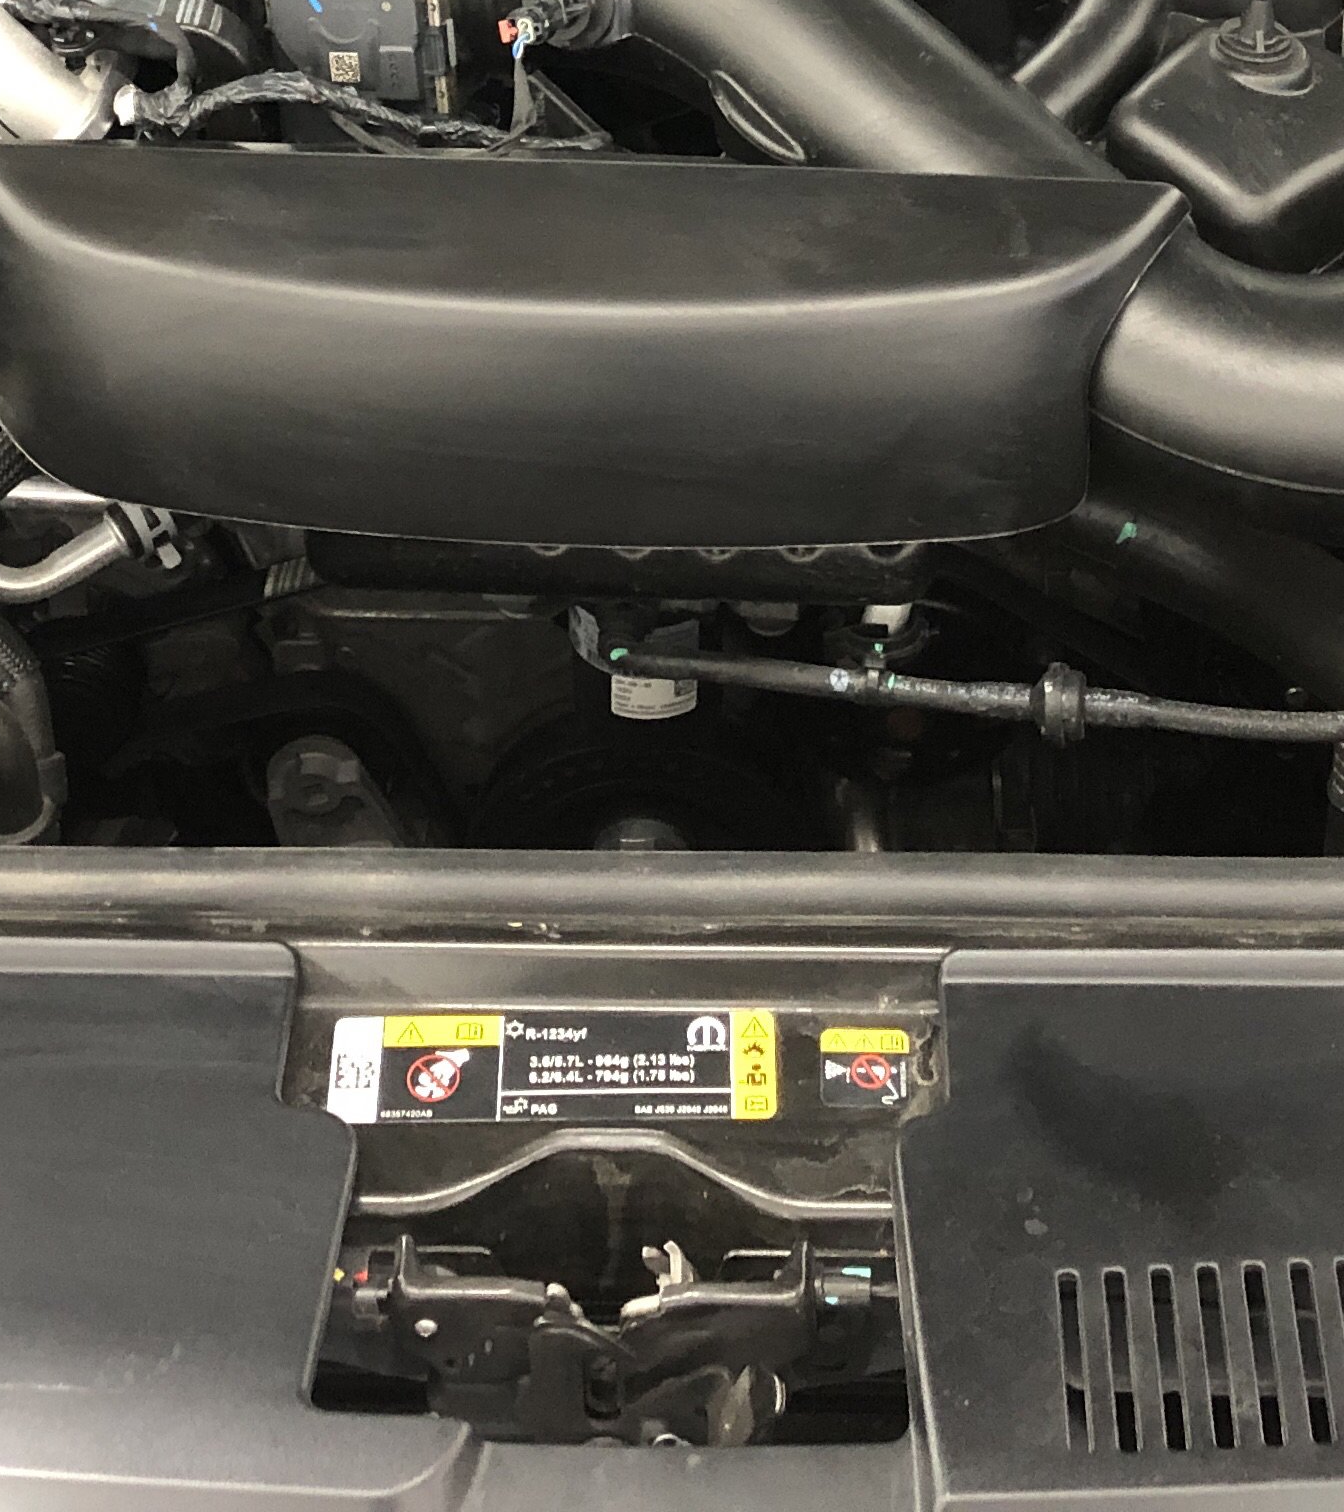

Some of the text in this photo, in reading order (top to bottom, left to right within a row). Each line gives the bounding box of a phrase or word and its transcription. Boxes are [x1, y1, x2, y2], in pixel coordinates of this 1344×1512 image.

[525, 1026, 588, 1042] R-1234yf
[633, 1053, 666, 1068] (2.13
[669, 1053, 695, 1068] lbs)
[669, 1069, 695, 1084] lbs)
[530, 1103, 558, 1115] PAG
